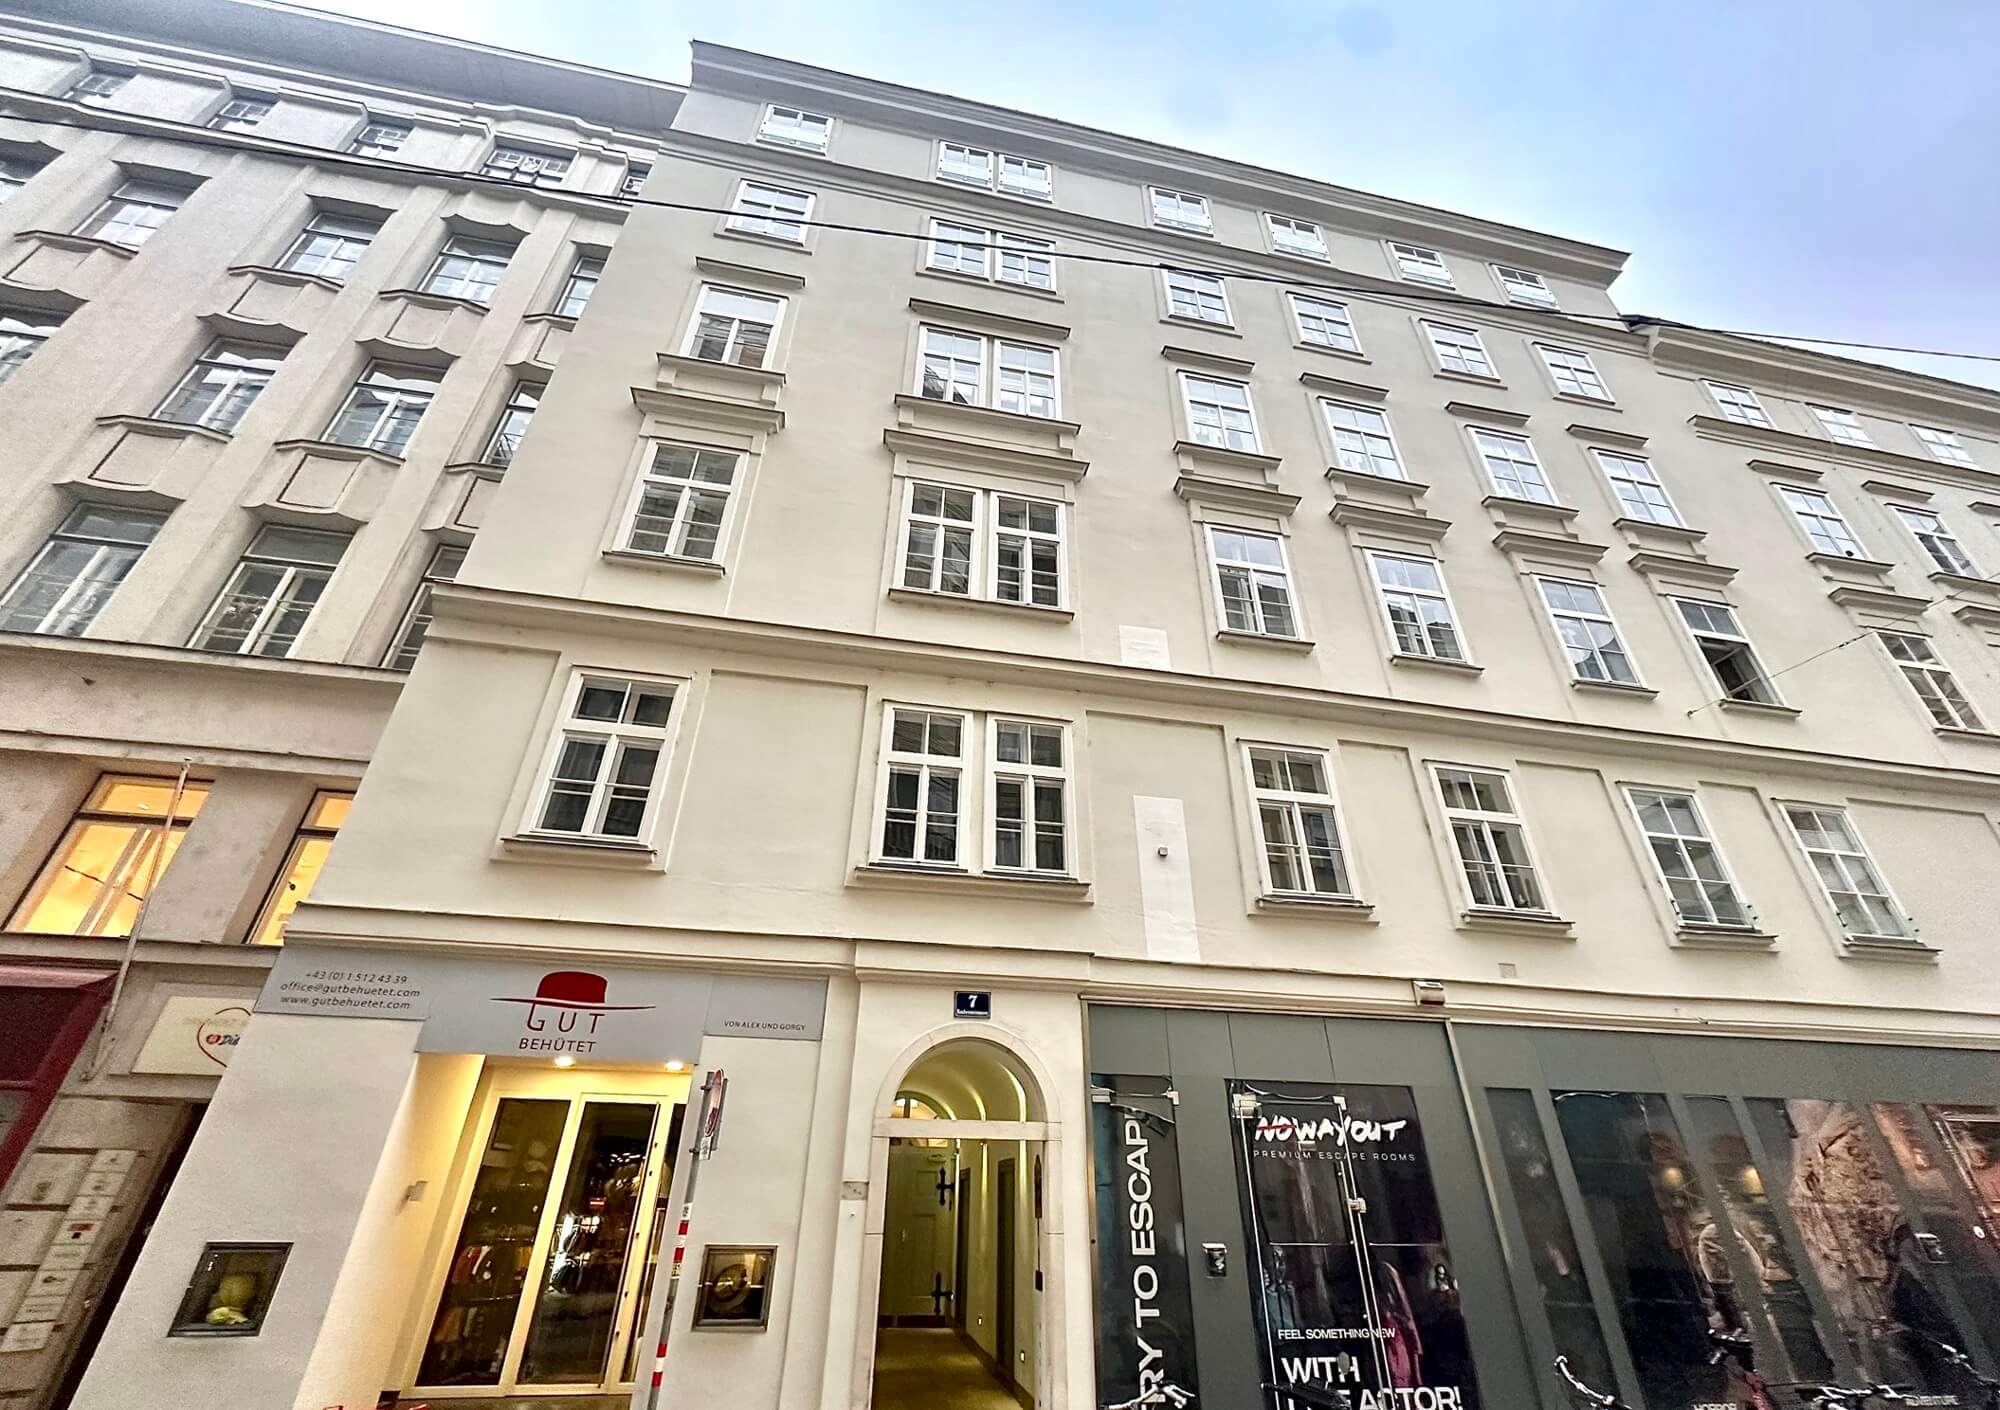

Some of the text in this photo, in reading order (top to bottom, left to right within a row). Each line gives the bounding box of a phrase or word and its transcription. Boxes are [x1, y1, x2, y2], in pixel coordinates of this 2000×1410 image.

[306, 971, 327, 980] +43
[328, 971, 344, 981] (0)
[354, 972, 375, 982] 512
[377, 974, 391, 983] 43
[393, 975, 408, 984] 39
[280, 982, 420, 998] office@gutbehuetet.com
[280, 996, 411, 1010] www.gutbehuetet.com
[968, 995, 978, 1008] 7
[526, 1002, 606, 1034] GUT
[724, 1020, 741, 1028] VON
[741, 1021, 760, 1029] ALEX
[762, 1022, 778, 1030] UND
[518, 1037, 598, 1053] BEHÜTET
[1253, 1150, 1416, 1162] PREMIUM ESCAPE ROOMS
[1124, 1113, 1157, 1256] ESCAP
[1133, 1265, 1160, 1328] TO
[1278, 1328, 1395, 1340] FEEL SOMETHING NEW
[1281, 1356, 1360, 1385] WITH
